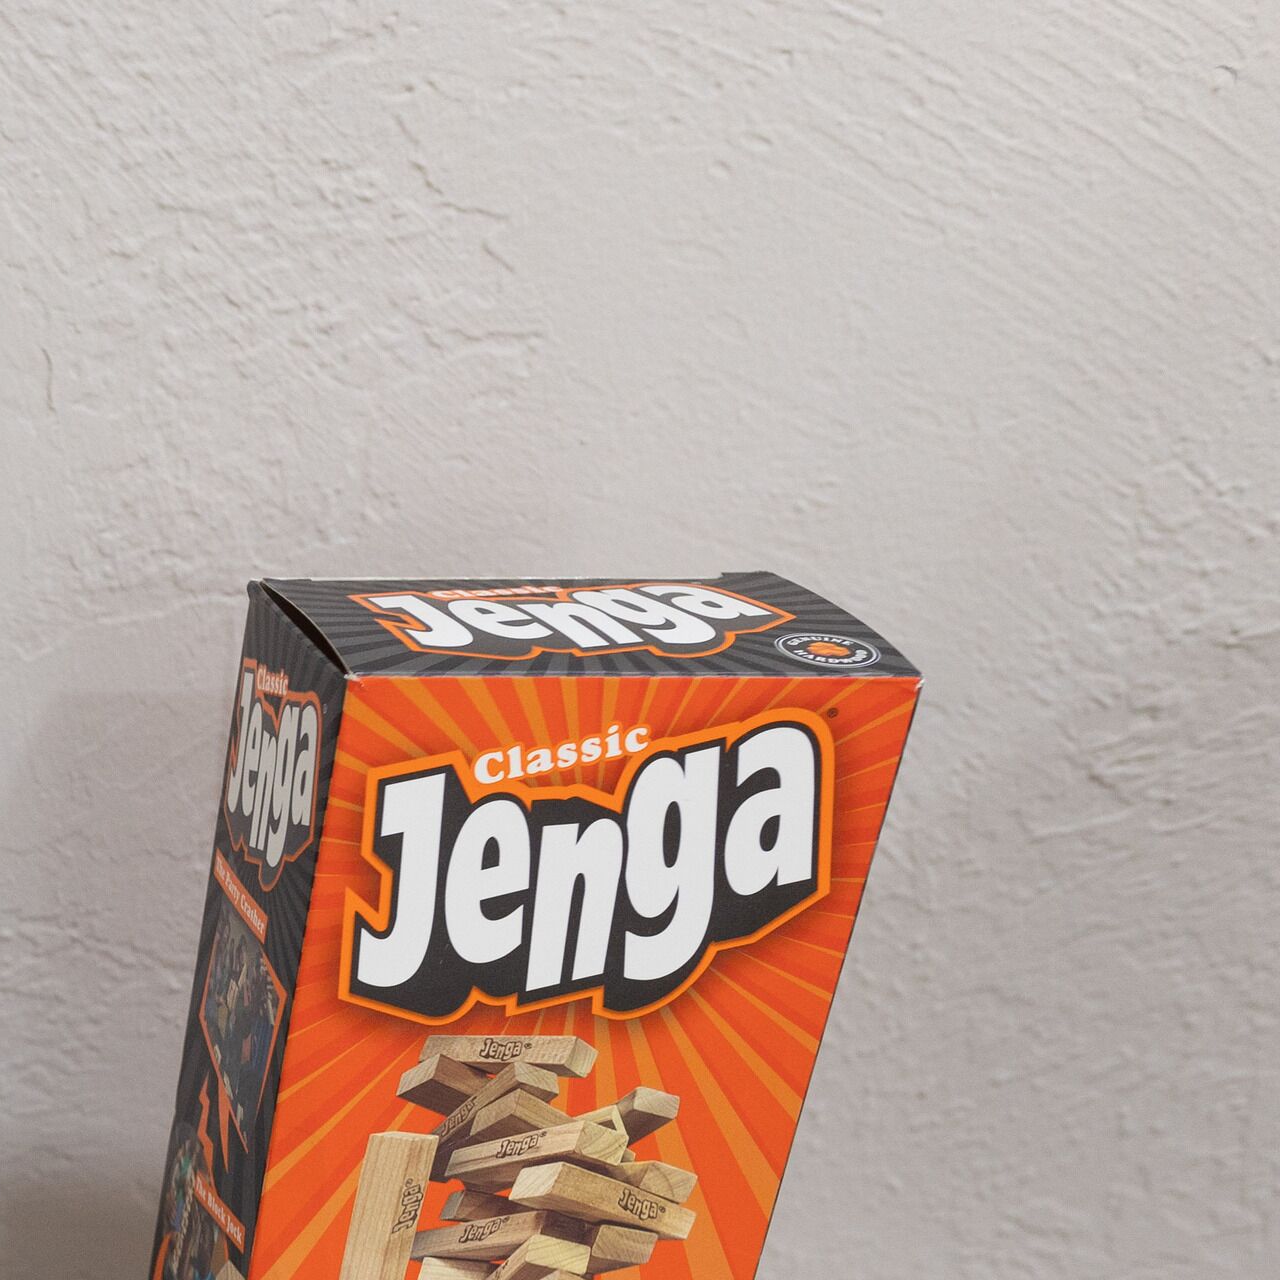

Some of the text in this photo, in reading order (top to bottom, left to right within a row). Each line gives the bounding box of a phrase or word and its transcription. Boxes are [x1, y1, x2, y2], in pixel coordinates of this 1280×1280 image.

[368, 585, 771, 648] Jenga
[257, 668, 288, 696] Classic
[227, 671, 318, 868] Jenga
[473, 725, 651, 786] Classic
[358, 726, 813, 993] Jenga
[480, 1038, 523, 1061] Jenga
[496, 1133, 540, 1158] Jenga
[392, 1182, 424, 1234] Jenga
[619, 1188, 658, 1220] Jenga
[459, 1217, 502, 1243] Jenga
